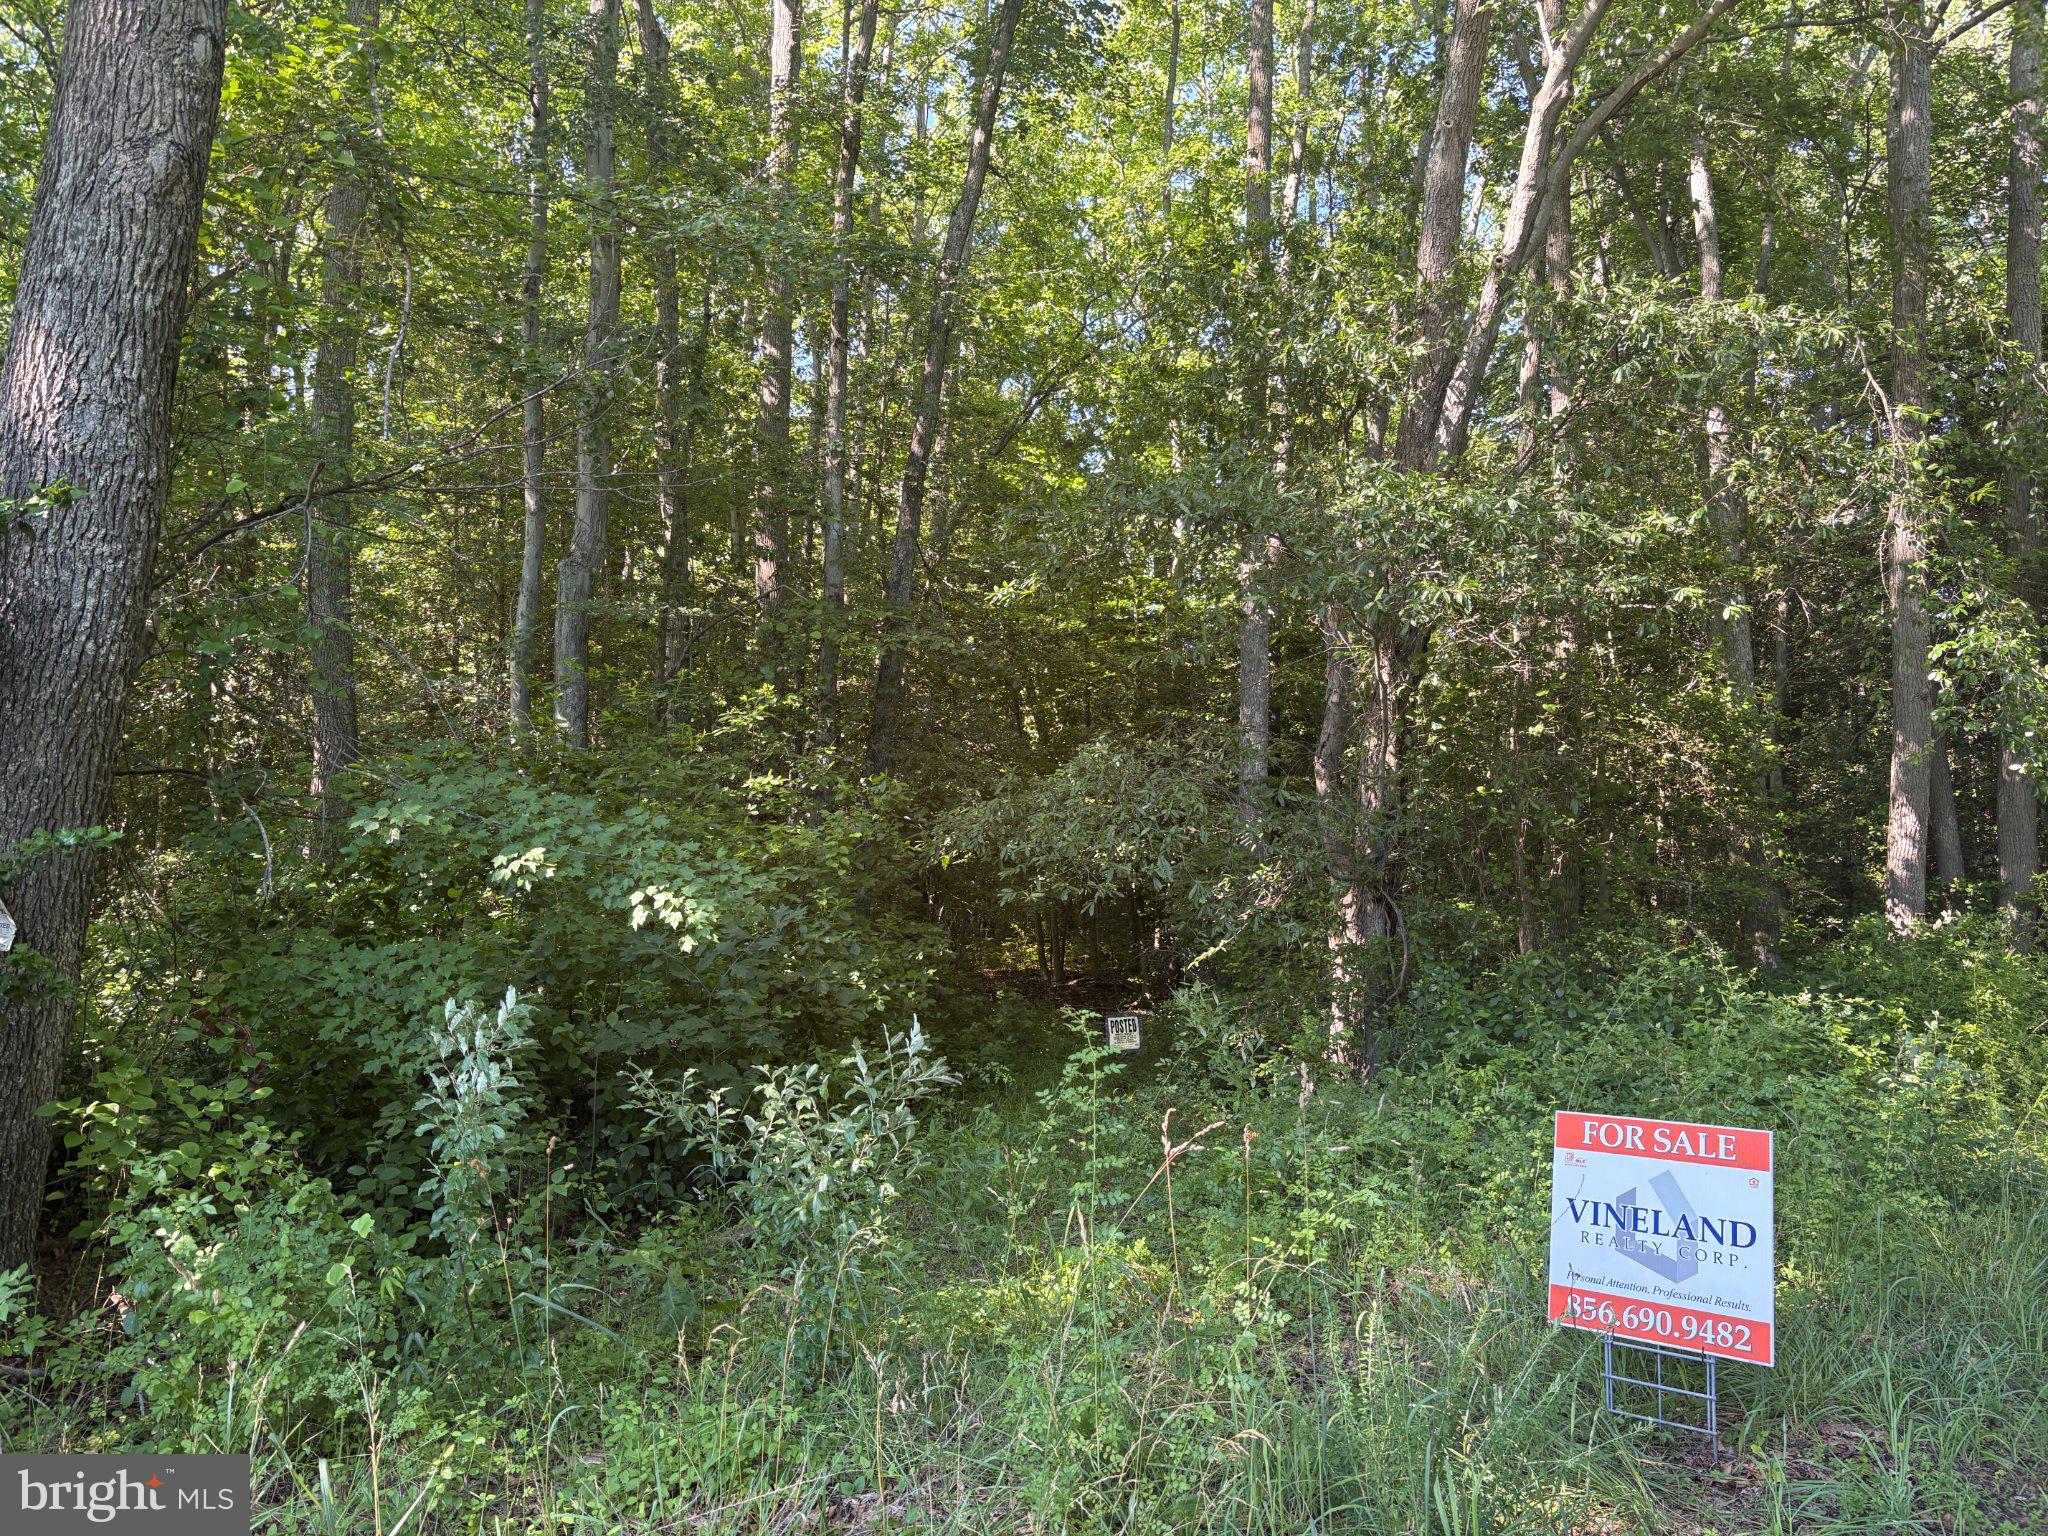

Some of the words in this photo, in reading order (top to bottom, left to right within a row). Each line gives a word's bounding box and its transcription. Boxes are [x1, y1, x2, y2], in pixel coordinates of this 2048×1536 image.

[1110, 1018, 1137, 1034] POSTED
[1581, 1120, 1646, 1151] FOR
[1653, 1128, 1737, 1161] SALE
[1566, 1197, 1757, 1248] VINELAND
[1581, 1233, 1663, 1255] REALTY
[1679, 1247, 1748, 1269] CORP.
[1605, 1277, 1651, 1294] Attention.
[1652, 1285, 1713, 1305] Professional
[1714, 1298, 1752, 1312] Results.
[1566, 1294, 1753, 1352] 856.690.9482
